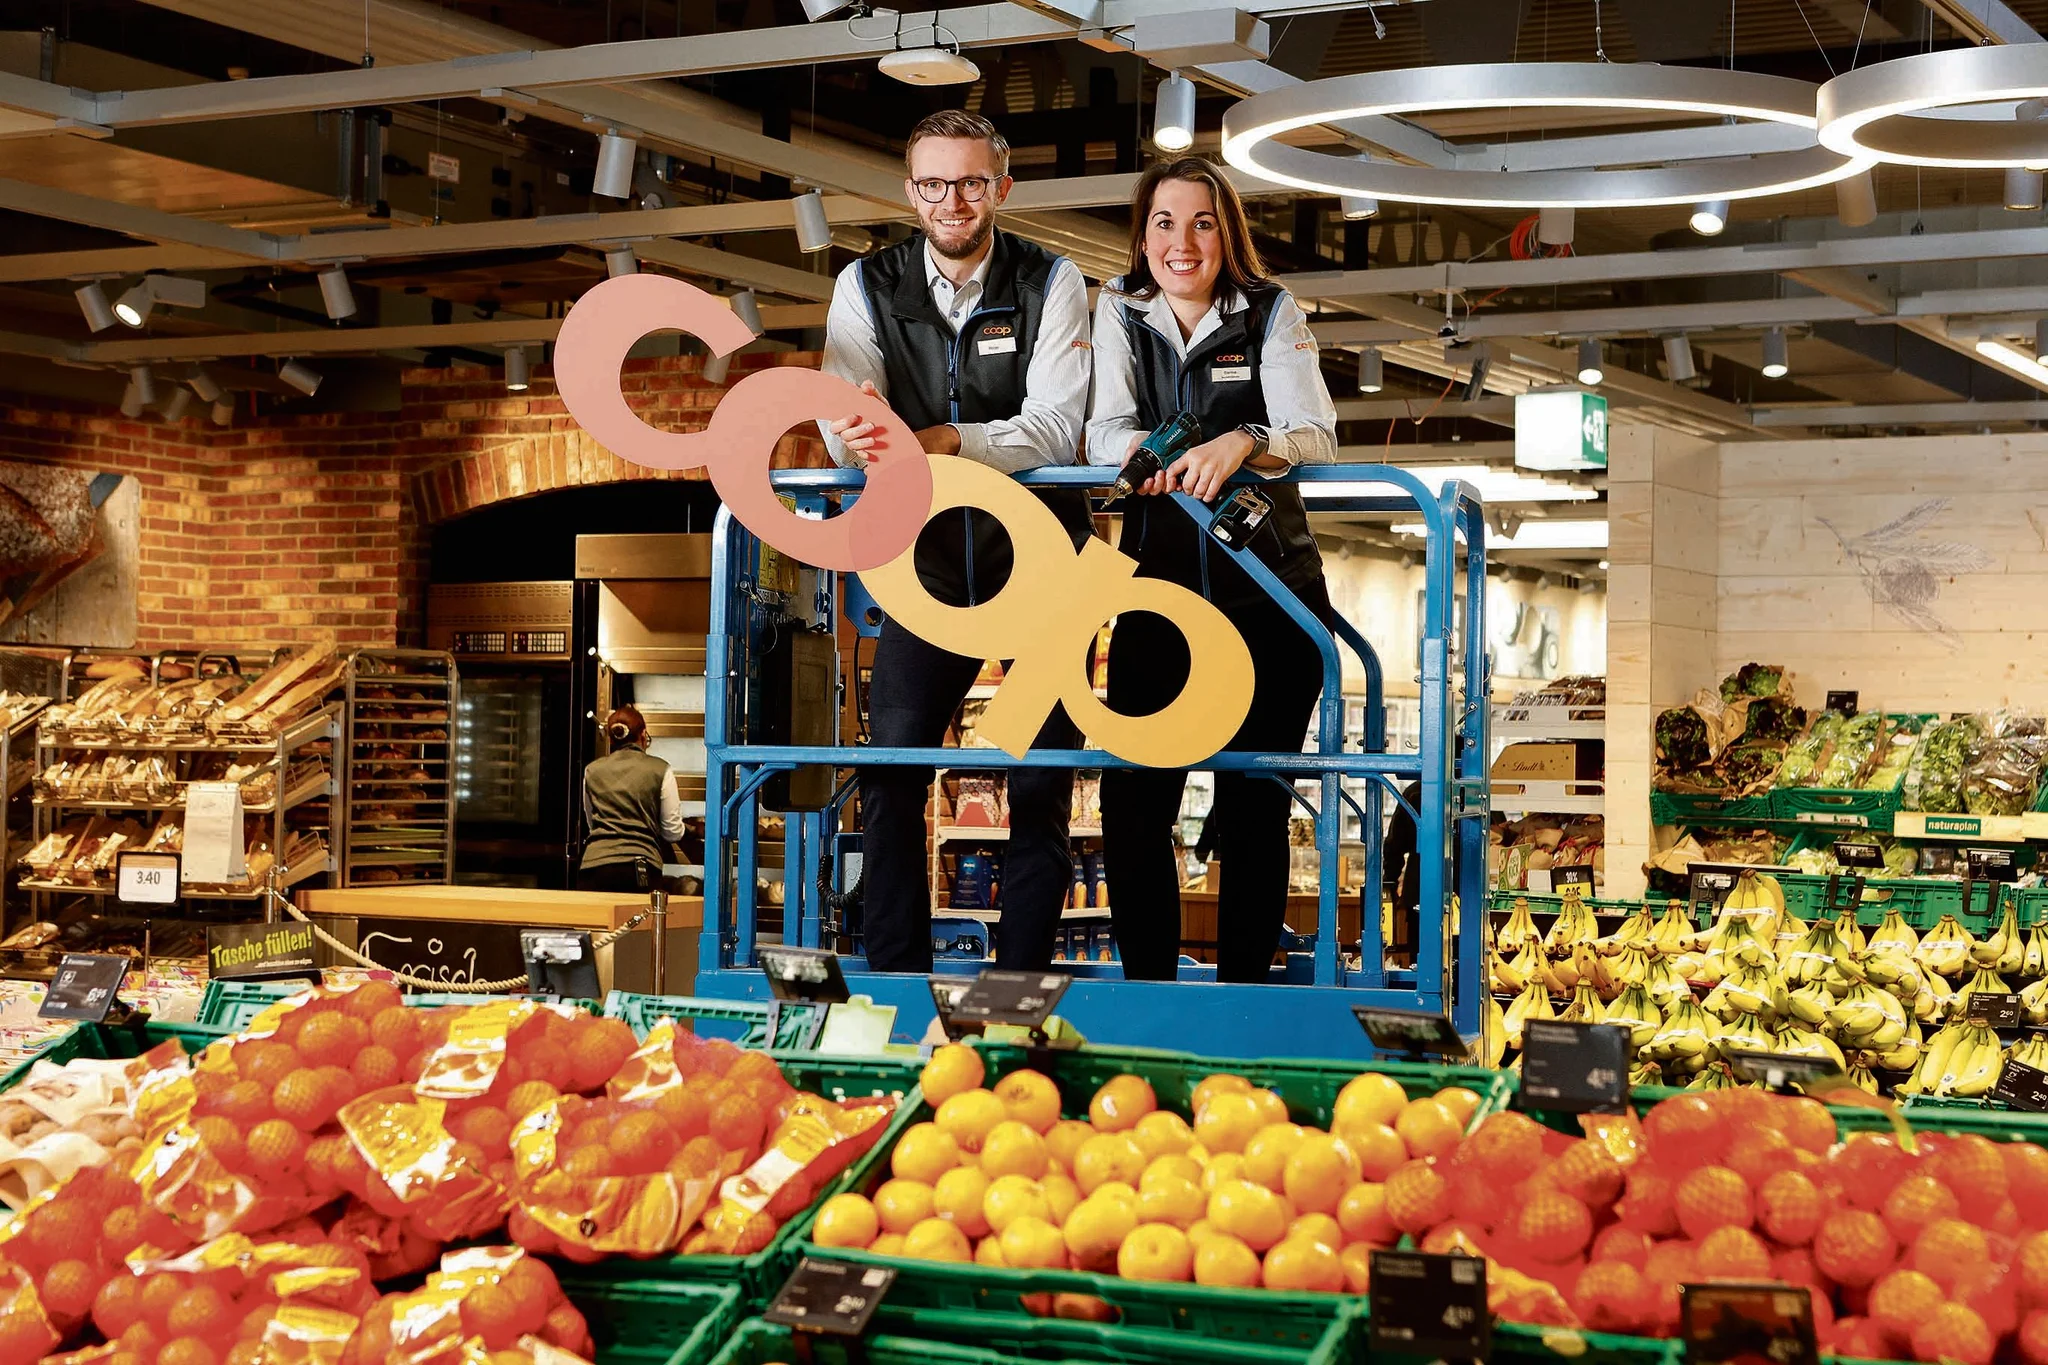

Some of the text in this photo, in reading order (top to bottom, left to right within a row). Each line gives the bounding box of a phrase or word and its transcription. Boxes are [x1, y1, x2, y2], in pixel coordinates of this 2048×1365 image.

[983, 326, 1012, 335] coop
[1216, 354, 1244, 363] coop
[1511, 761, 1539, 771] Lindt
[1928, 821, 1978, 832] naturaplan
[136, 871, 161, 886] 3.40
[210, 925, 313, 969] Tasche füllen!
